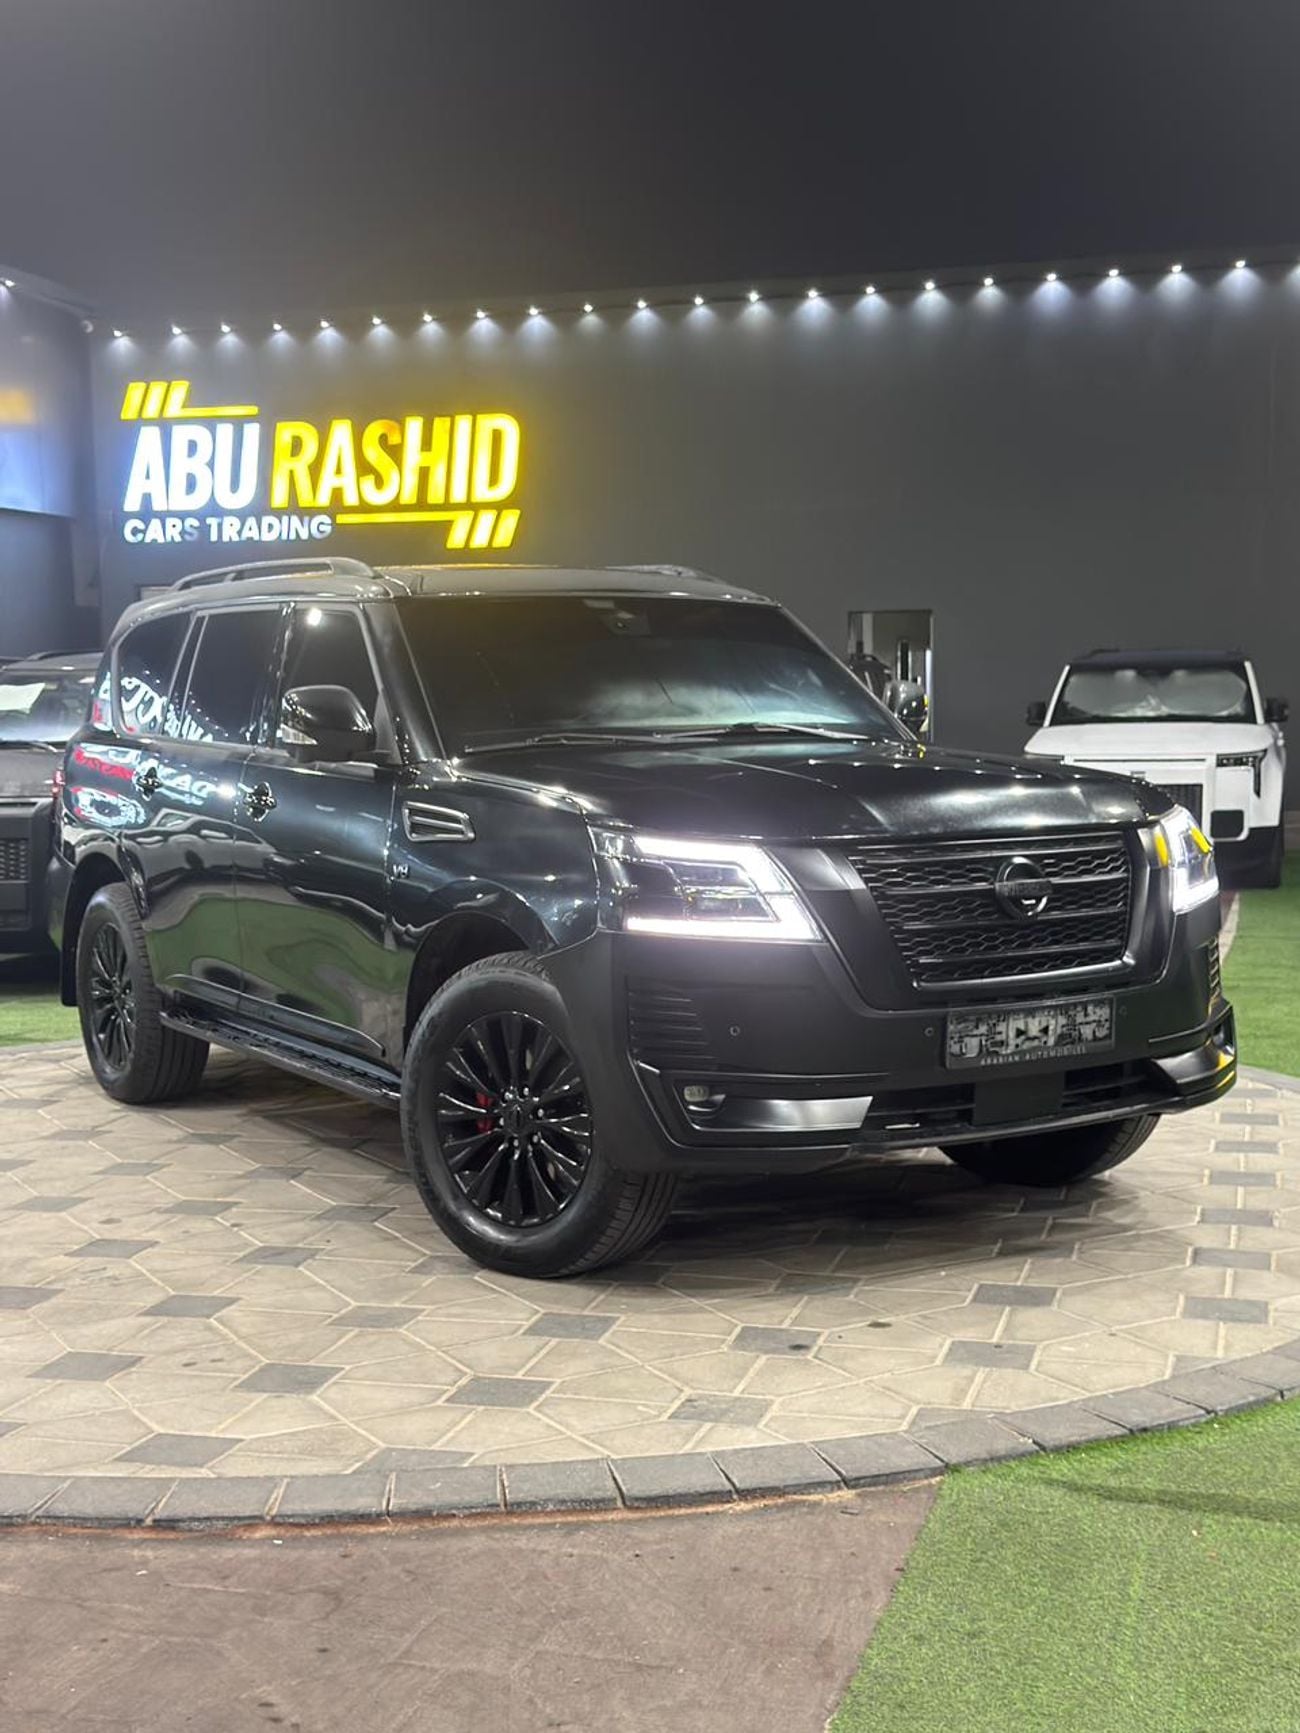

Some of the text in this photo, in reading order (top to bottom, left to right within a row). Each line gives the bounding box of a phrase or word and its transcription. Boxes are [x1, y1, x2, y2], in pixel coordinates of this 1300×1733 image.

[123, 413, 520, 511] ABU RASHID
[123, 514, 332, 543] CARS TRADING
[980, 1054, 1020, 1066] ARABIAN
